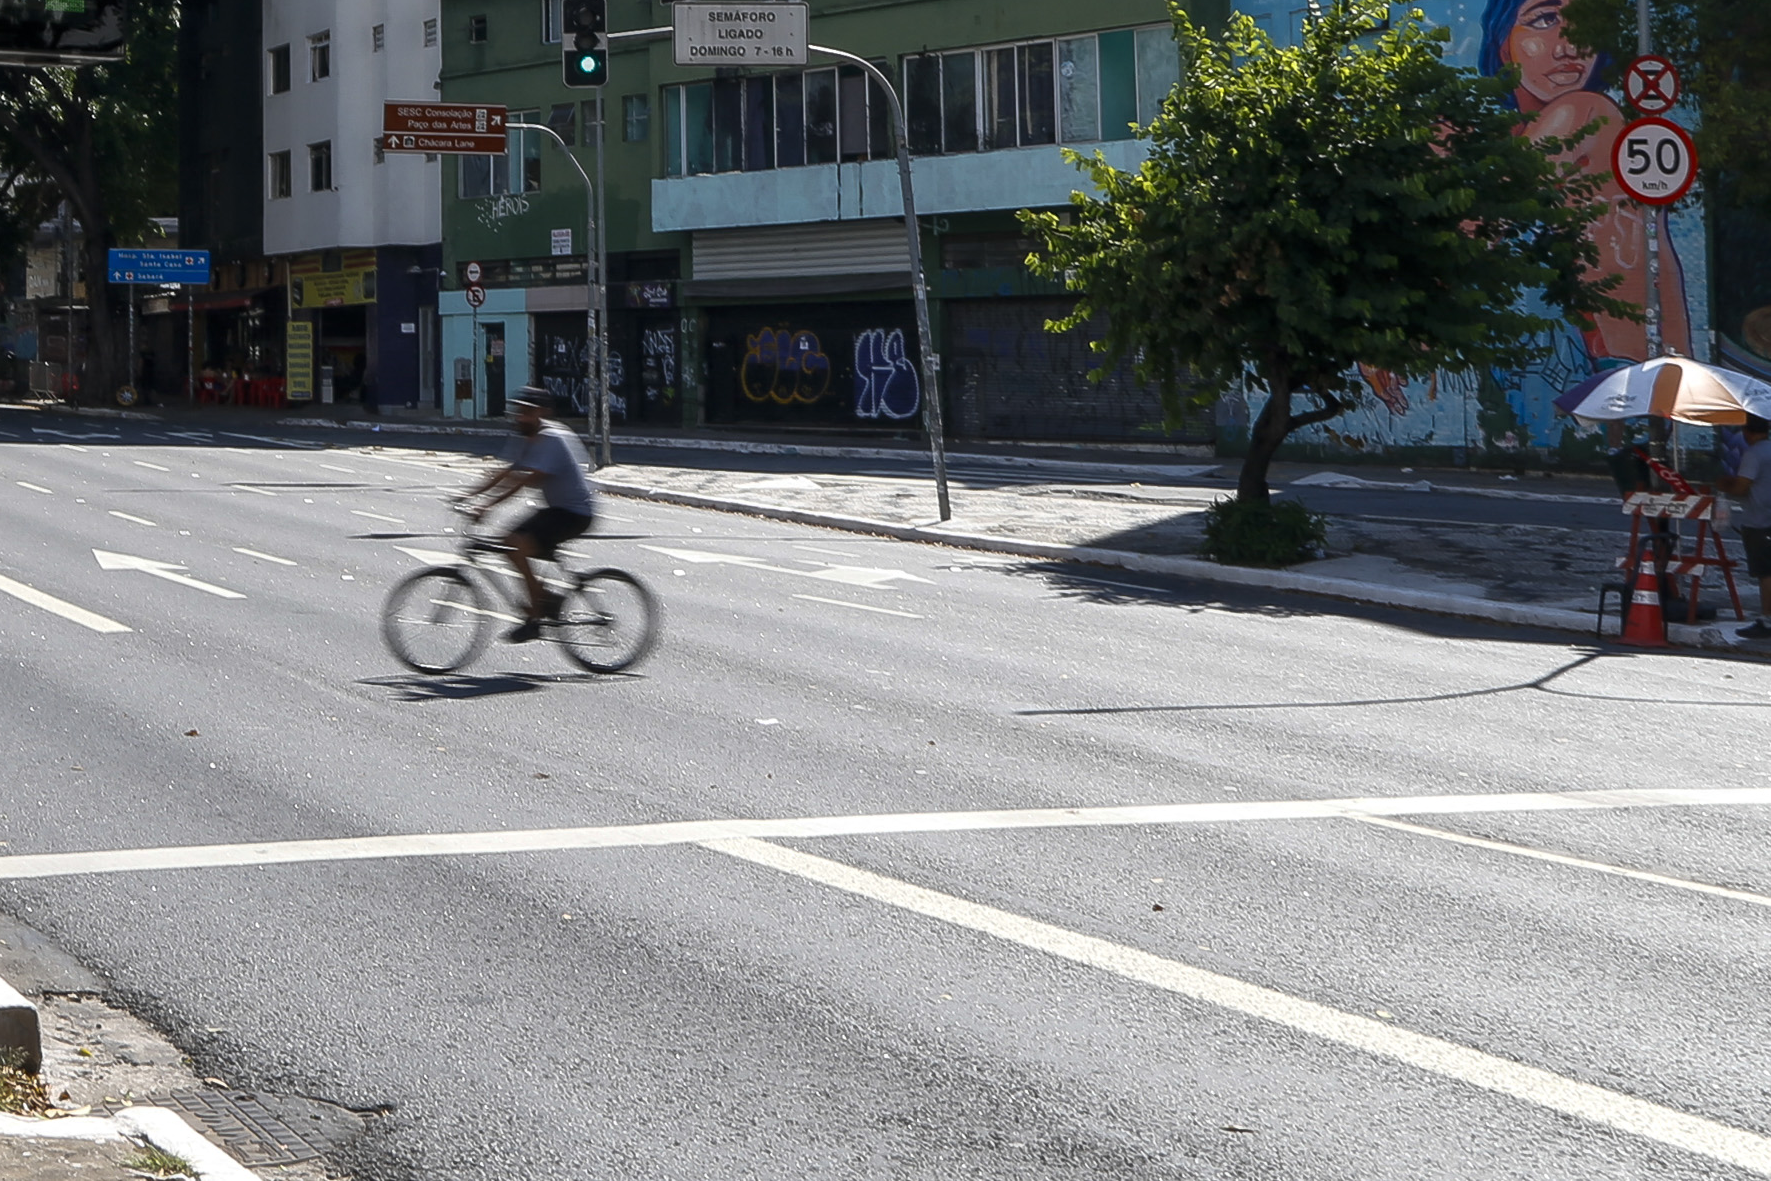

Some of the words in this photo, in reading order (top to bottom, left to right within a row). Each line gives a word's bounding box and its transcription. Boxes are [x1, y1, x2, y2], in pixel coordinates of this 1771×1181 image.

[708, 9, 776, 23] SEMÁFORO
[718, 28, 764, 40] LIGADO
[690, 45, 747, 57] DOMINGO
[754, 46, 762, 57] 7
[771, 46, 783, 57] 16
[785, 46, 794, 57] h
[397, 107, 422, 117] SESC
[425, 108, 473, 119] Consolação
[408, 119, 429, 130] Paço
[432, 120, 448, 129] das
[450, 120, 472, 130] Artes
[418, 138, 452, 148] Chácara
[454, 139, 475, 148] Lane
[1626, 137, 1681, 175] 50
[1641, 179, 1668, 191] km/h
